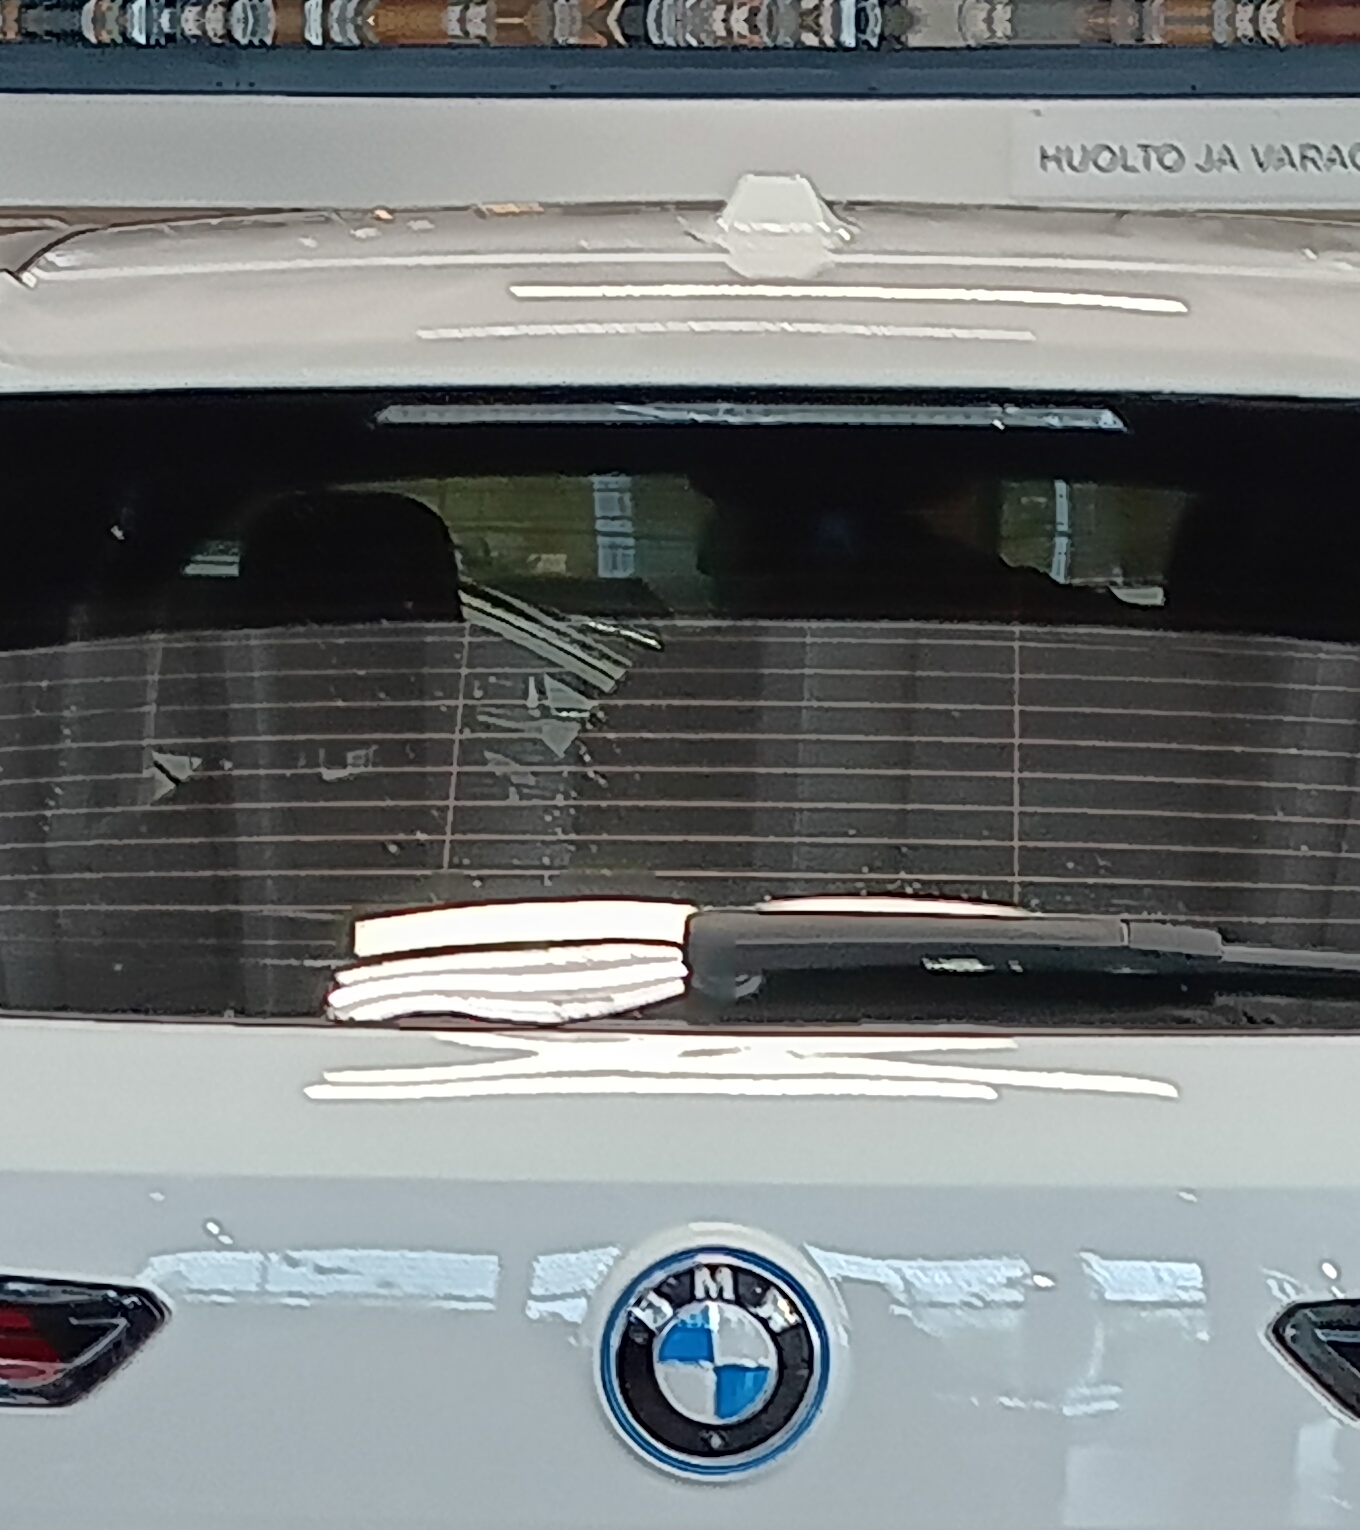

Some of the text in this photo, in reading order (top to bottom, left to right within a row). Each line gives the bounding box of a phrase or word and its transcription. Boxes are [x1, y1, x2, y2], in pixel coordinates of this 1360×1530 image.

[1039, 140, 1186, 175] HUOLTO
[1195, 141, 1241, 174] JA
[627, 1265, 802, 1335] BMW
